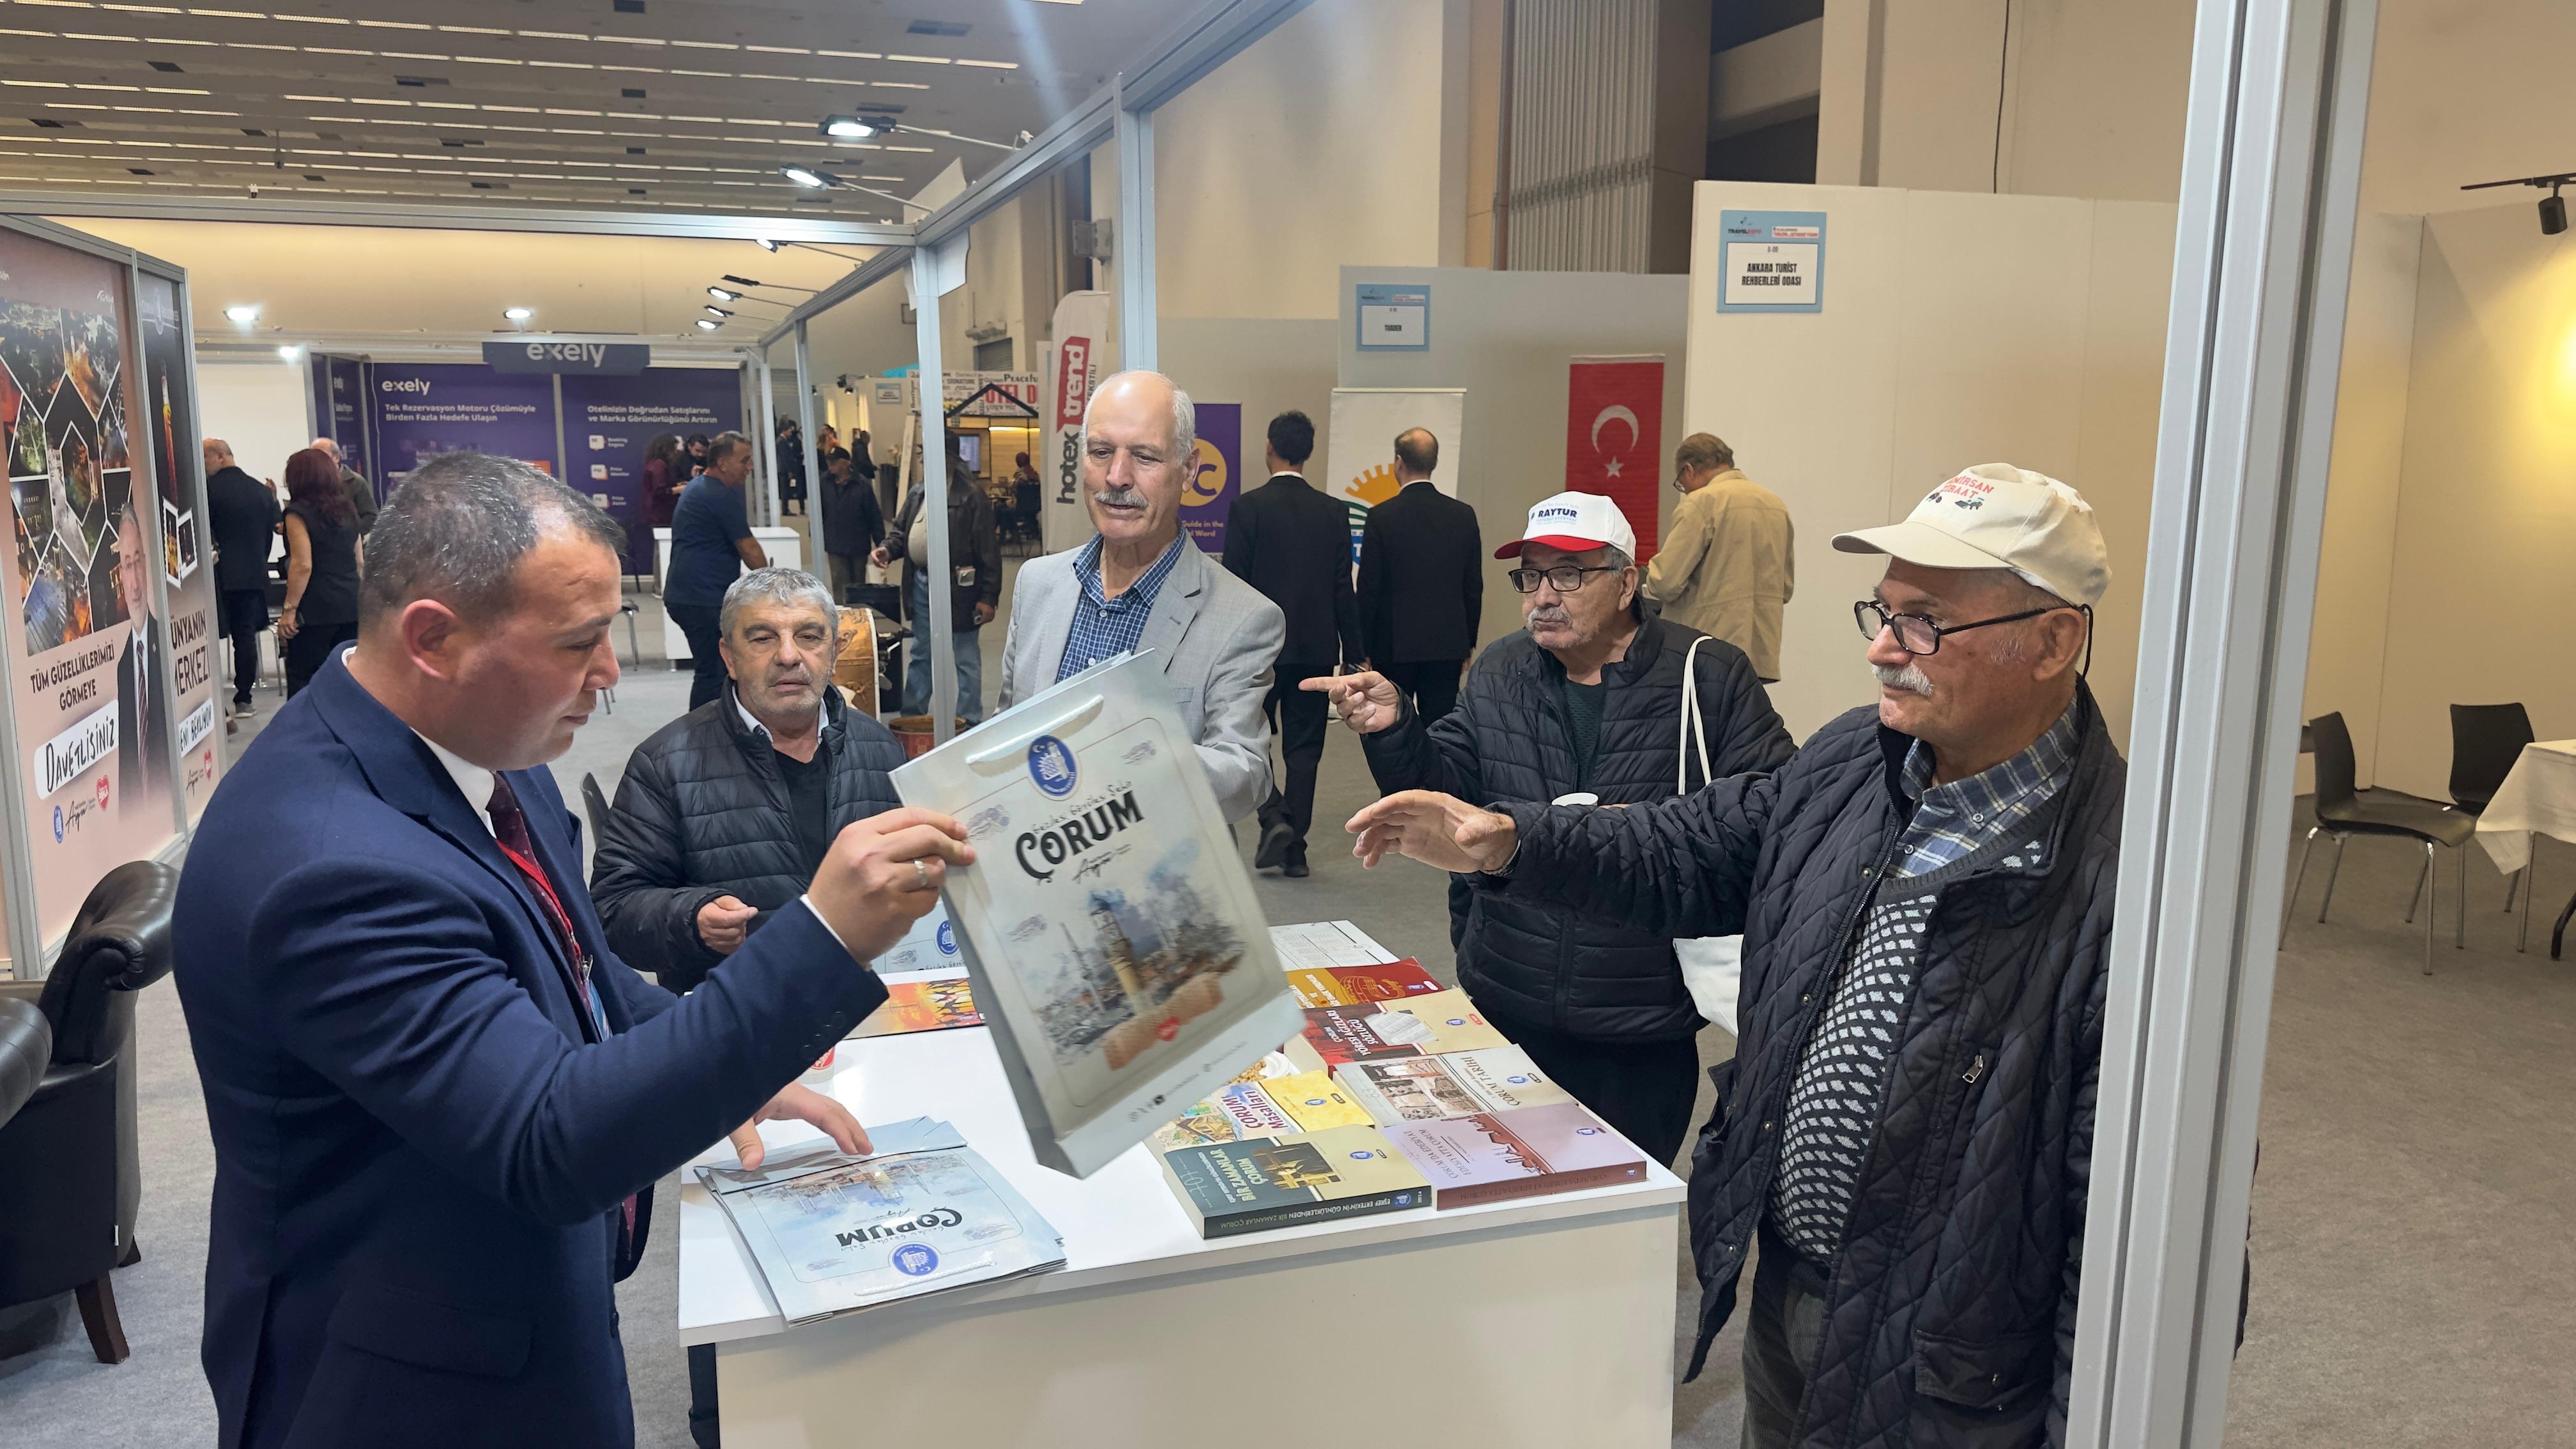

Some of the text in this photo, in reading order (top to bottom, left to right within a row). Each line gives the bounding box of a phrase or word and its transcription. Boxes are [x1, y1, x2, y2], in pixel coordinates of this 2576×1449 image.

[1747, 261, 1797, 273] ANKARA TURİST
[1742, 275, 1801, 286] REHBERLERİ ODASI
[526, 342, 606, 368] exely
[382, 378, 431, 395] exely
[1063, 344, 1084, 418] trend
[402, 404, 456, 415] Rezervasyon
[588, 406, 627, 414] Otelinizin
[1056, 431, 1080, 505] hotex
[1213, 519, 1224, 528] the
[1538, 508, 1577, 518] RAYTUR
[31, 640, 115, 694] TÜM GÜZELLİKLERİMİZİ
[59, 679, 96, 710] GÖRMEYE
[1016, 790, 1145, 886] ÇORUM
[1324, 1026, 1343, 1043] ÇORUM
[1326, 1009, 1353, 1035] AĞIZLARI
[1349, 1018, 1379, 1045] SÖZLÜĞÜ
[1347, 1032, 1371, 1056] YÖRESİ
[1461, 1056, 1493, 1081] TARİHİ
[1491, 1082, 1522, 1107] ÇORUM
[1245, 1091, 1289, 1129] Masalları
[1210, 1148, 1257, 1202] BİR ZAMANLAR
[1236, 1158, 1268, 1186] ÇORUM
[1375, 1198, 1392, 1208] EŞREF
[835, 1206, 962, 1246] ÇORUM
[1221, 1219, 1245, 1229] ÇORUM
[1246, 1216, 1277, 1226] ZAMANLAR
